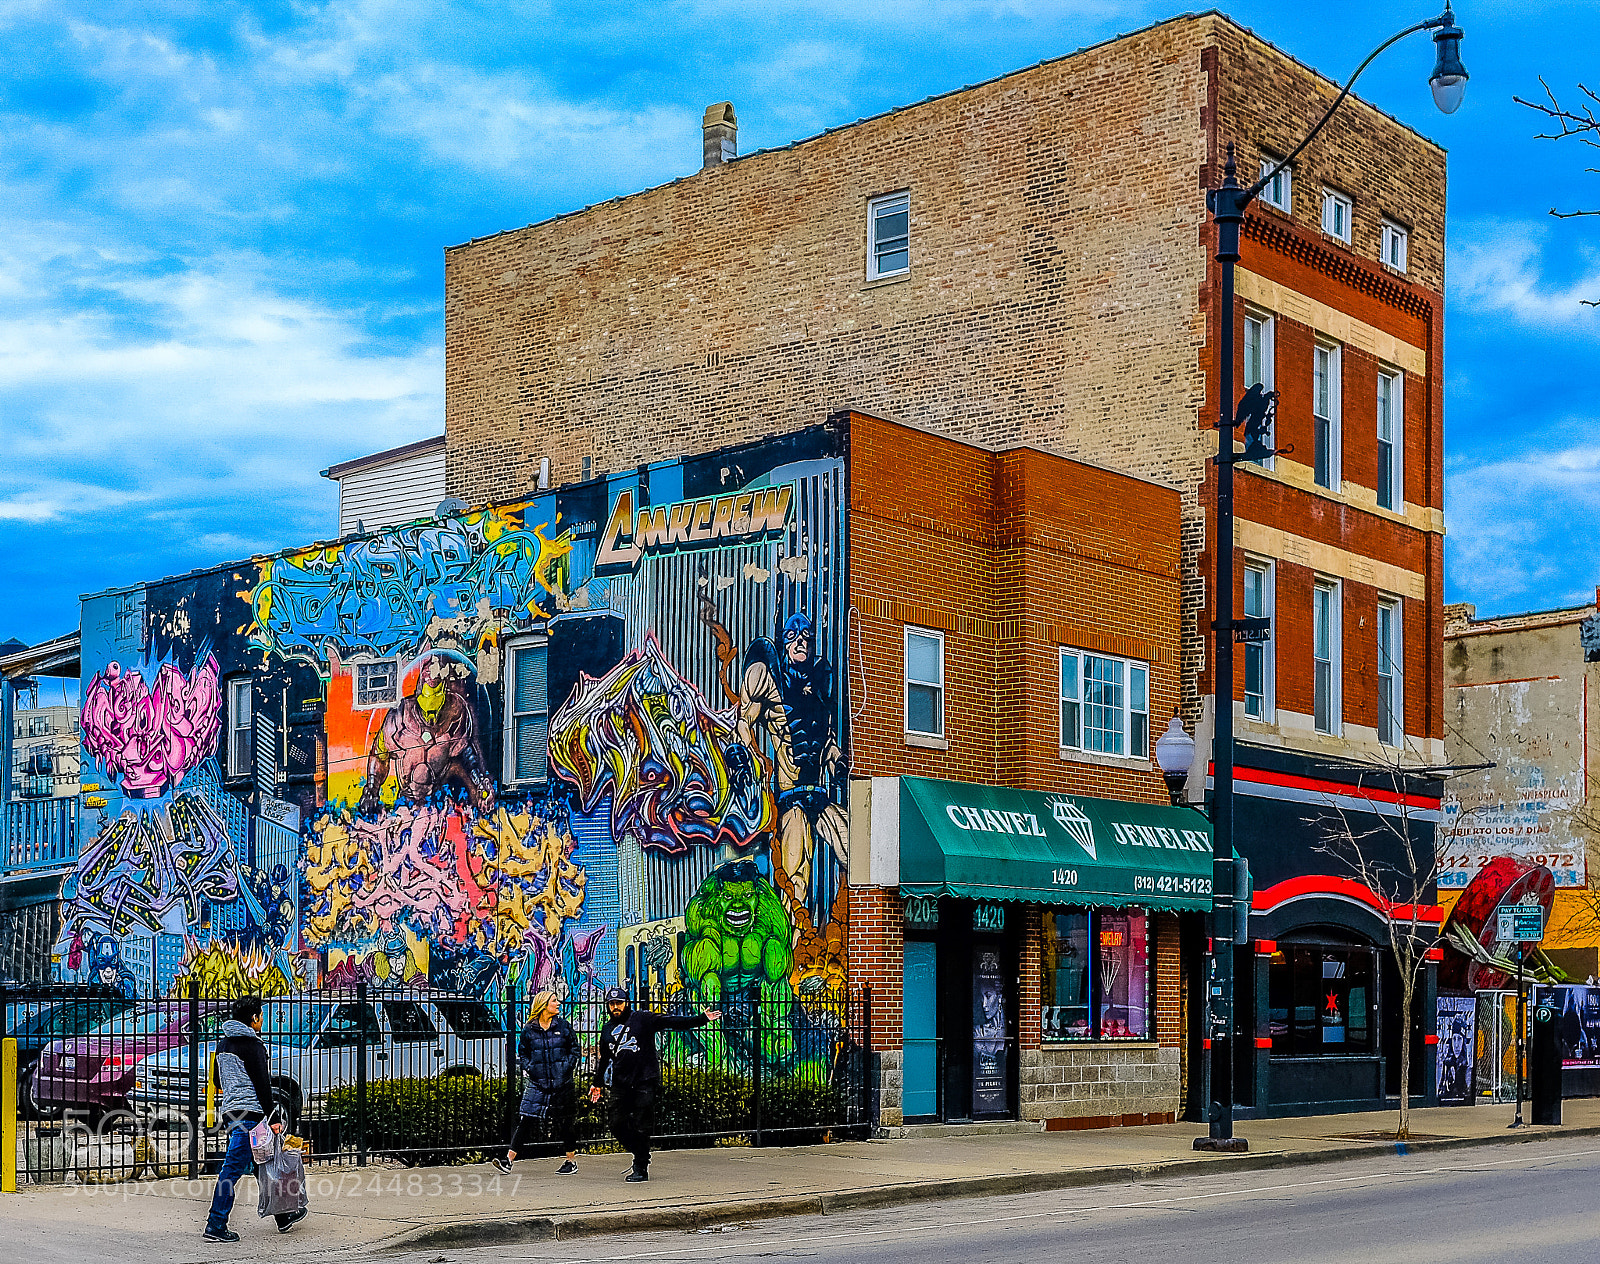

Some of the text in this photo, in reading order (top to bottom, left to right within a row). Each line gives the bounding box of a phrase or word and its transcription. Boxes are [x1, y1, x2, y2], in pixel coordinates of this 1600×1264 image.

[946, 805, 1214, 852] CHAVEZ JEWELRY
[1496, 826, 1515, 835] LOS
[1052, 868, 1078, 885] 1420
[1134, 875, 1213, 894] (312) 421-5123
[975, 904, 1005, 929] 1420
